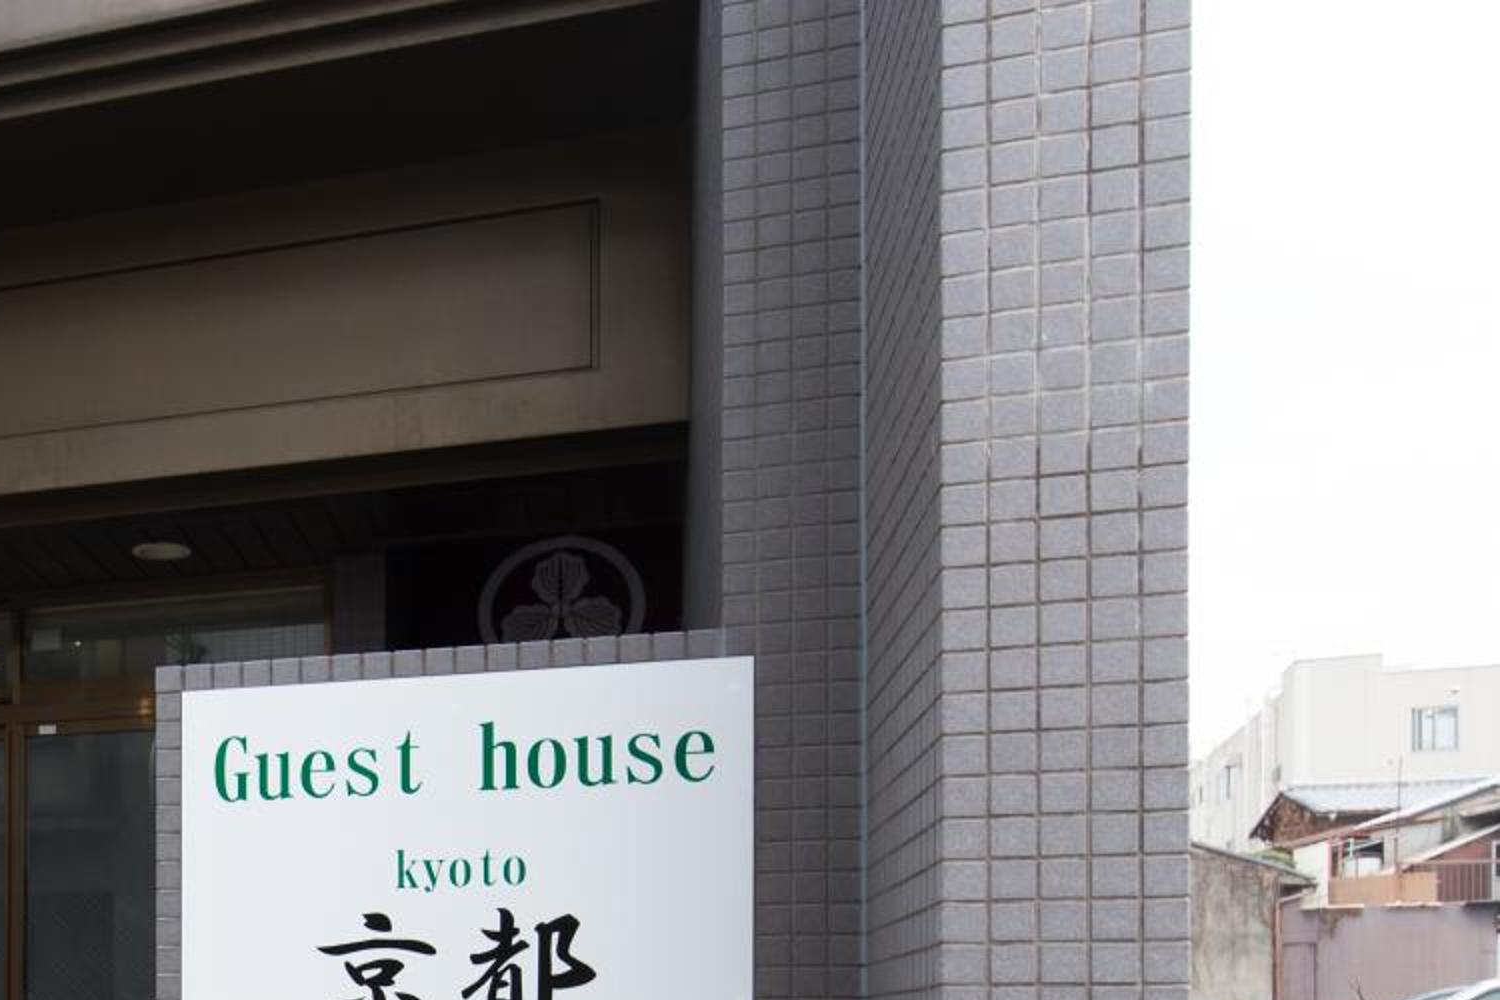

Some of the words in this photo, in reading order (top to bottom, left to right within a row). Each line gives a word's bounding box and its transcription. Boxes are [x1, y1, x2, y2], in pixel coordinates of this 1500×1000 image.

[214, 730, 422, 803] Guest
[478, 721, 715, 792] house
[396, 849, 527, 893] kyoto
